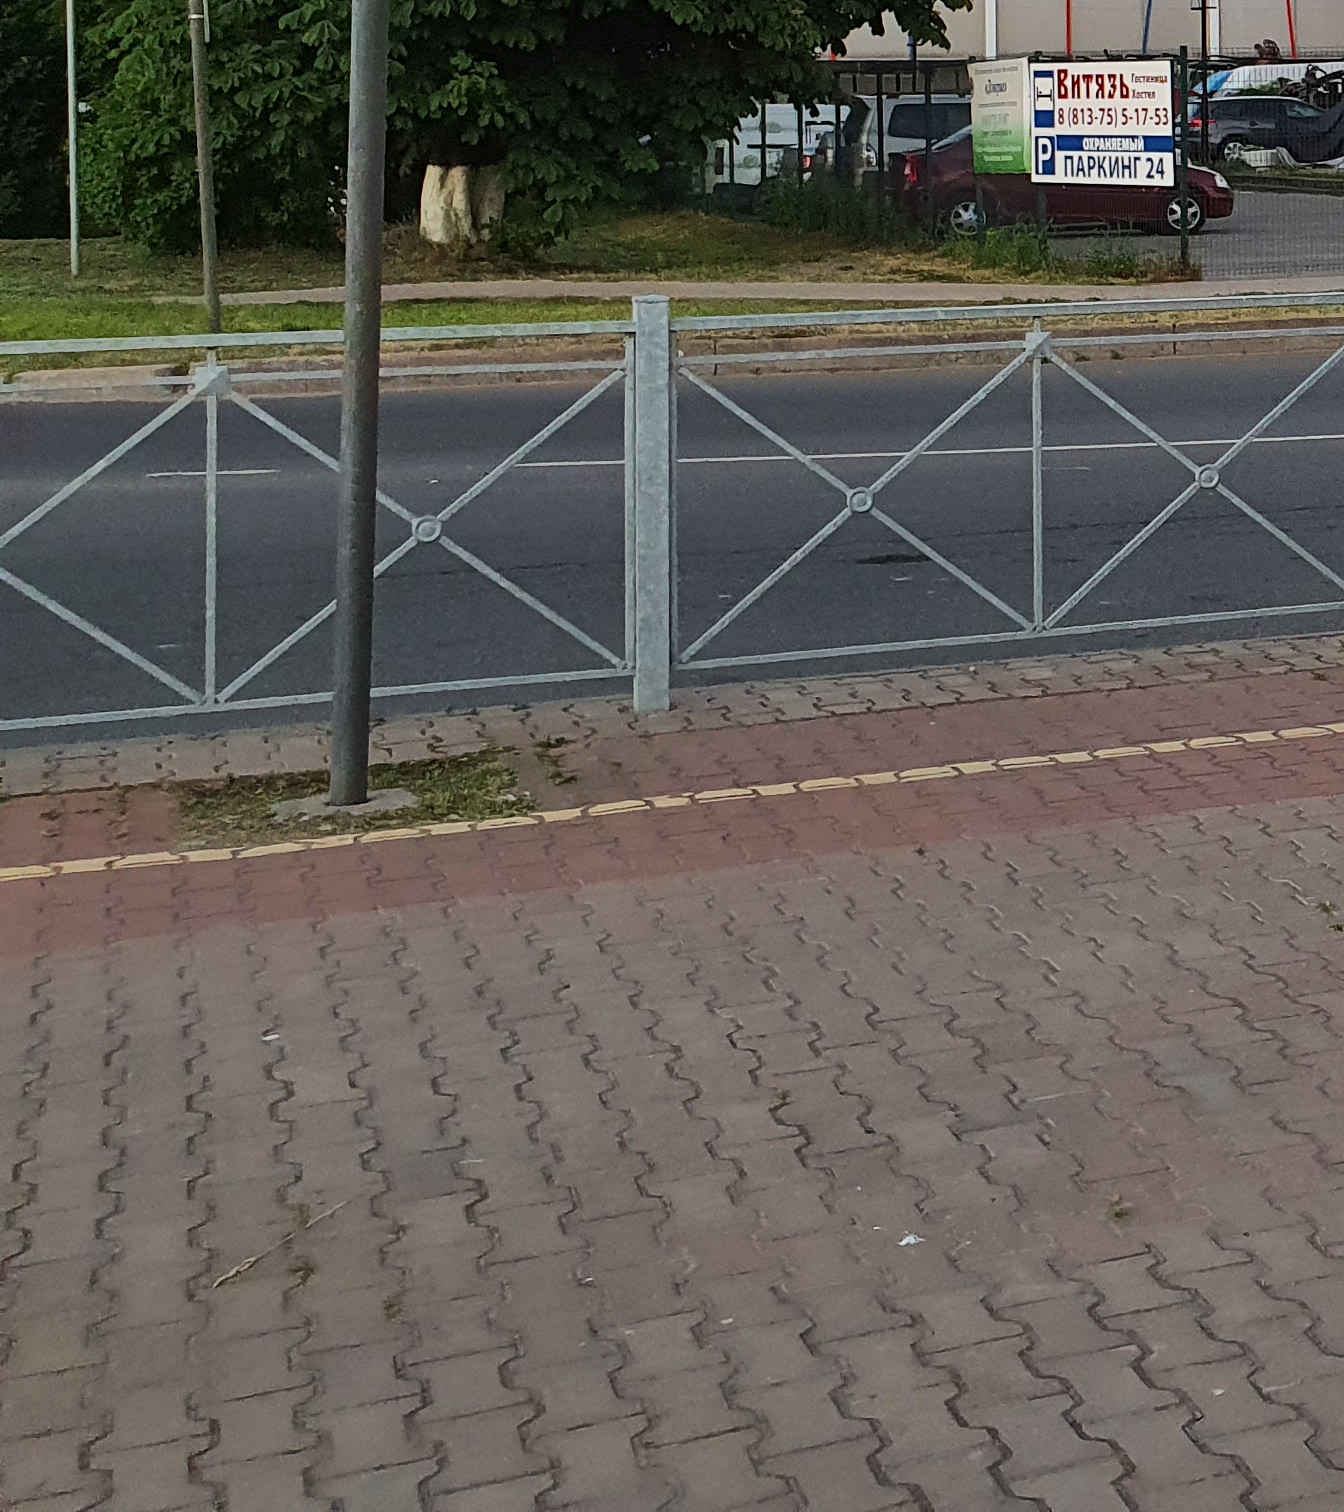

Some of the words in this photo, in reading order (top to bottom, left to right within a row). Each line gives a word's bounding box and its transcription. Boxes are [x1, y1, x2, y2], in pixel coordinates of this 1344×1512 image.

[1058, 108, 1065, 125] 8
[1068, 106, 1118, 128] (813-75)
[1121, 108, 1169, 126] 5-17-53
[1082, 136, 1145, 151] ОХРАНЯЕМЫЙ
[1064, 155, 1141, 179] ПАРКИНГ
[1145, 157, 1165, 179] 24
